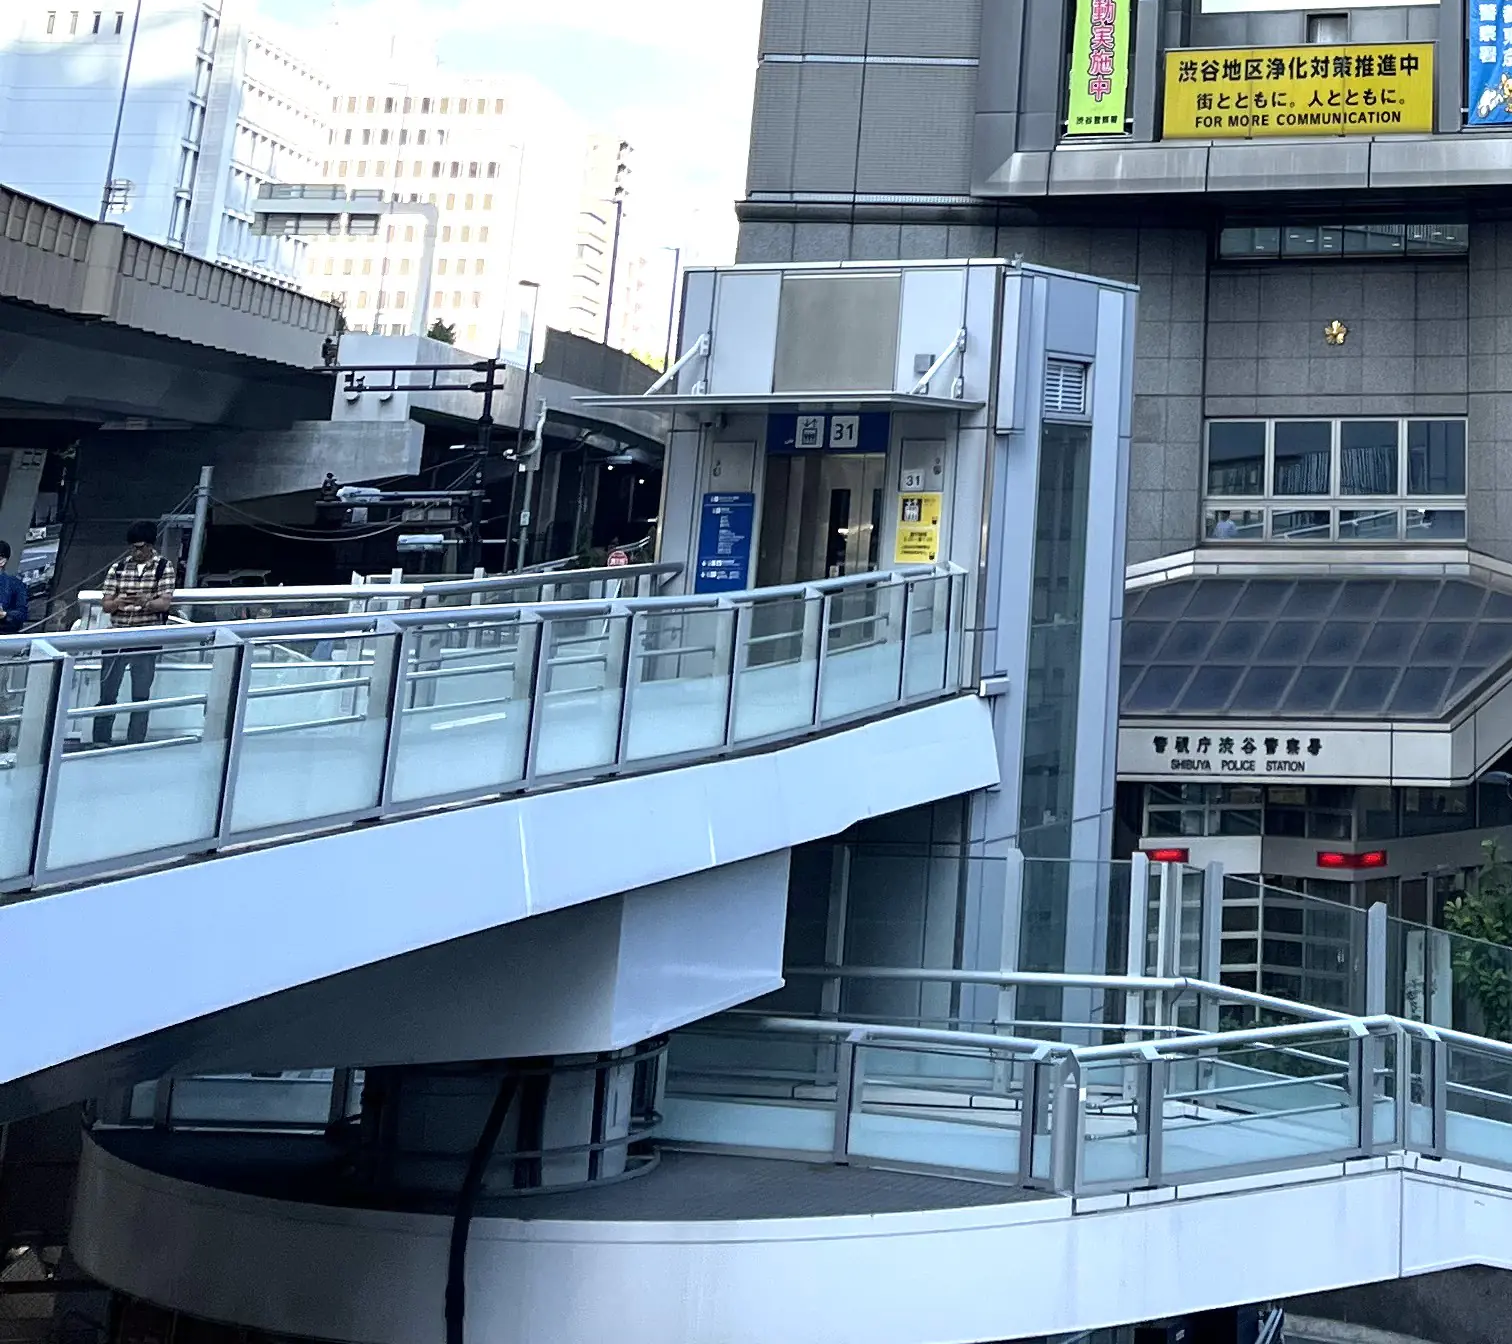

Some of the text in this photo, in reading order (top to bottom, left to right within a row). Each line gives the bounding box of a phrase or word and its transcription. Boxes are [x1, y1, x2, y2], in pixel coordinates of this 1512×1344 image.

[1178, 53, 1419, 82] 渋谷地区浄化対策推進中
[1196, 88, 1405, 111] 街とともに。 人とともに。
[1195, 111, 1401, 128] FOR MORE COMMUNICATION
[833, 423, 854, 441] 31
[905, 475, 921, 487] 31
[1171, 759, 1306, 772] SHIBUYA POLICE STATION
